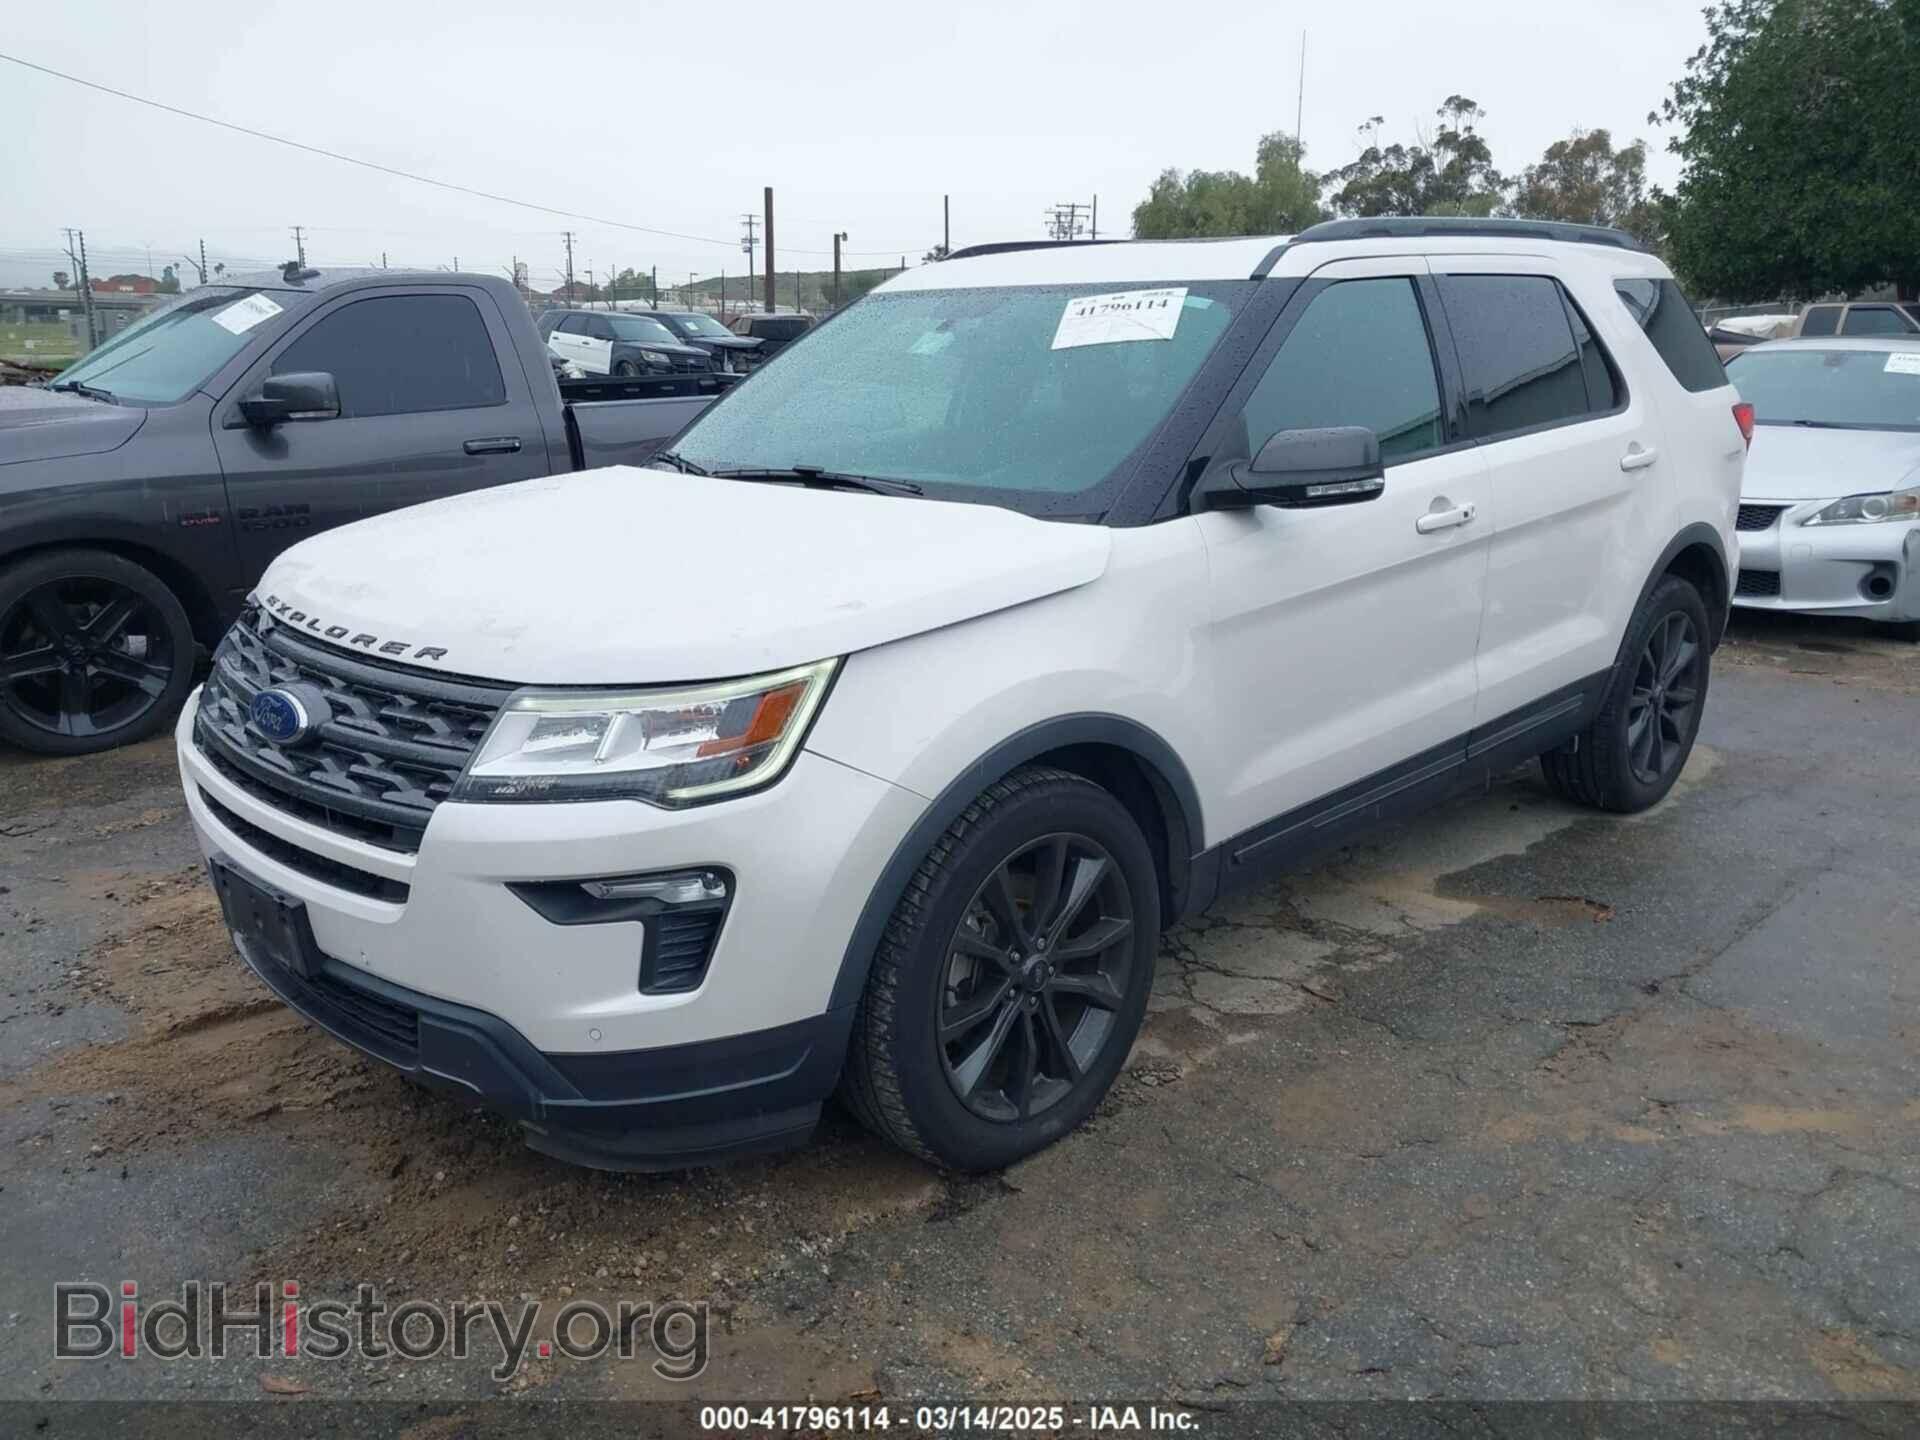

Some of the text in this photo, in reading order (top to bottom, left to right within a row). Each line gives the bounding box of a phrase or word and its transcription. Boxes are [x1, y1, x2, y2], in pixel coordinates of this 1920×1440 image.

[1075, 298, 1169, 317] 41796114
[265, 594, 449, 661] EXPLORER
[254, 695, 288, 732] Ford
